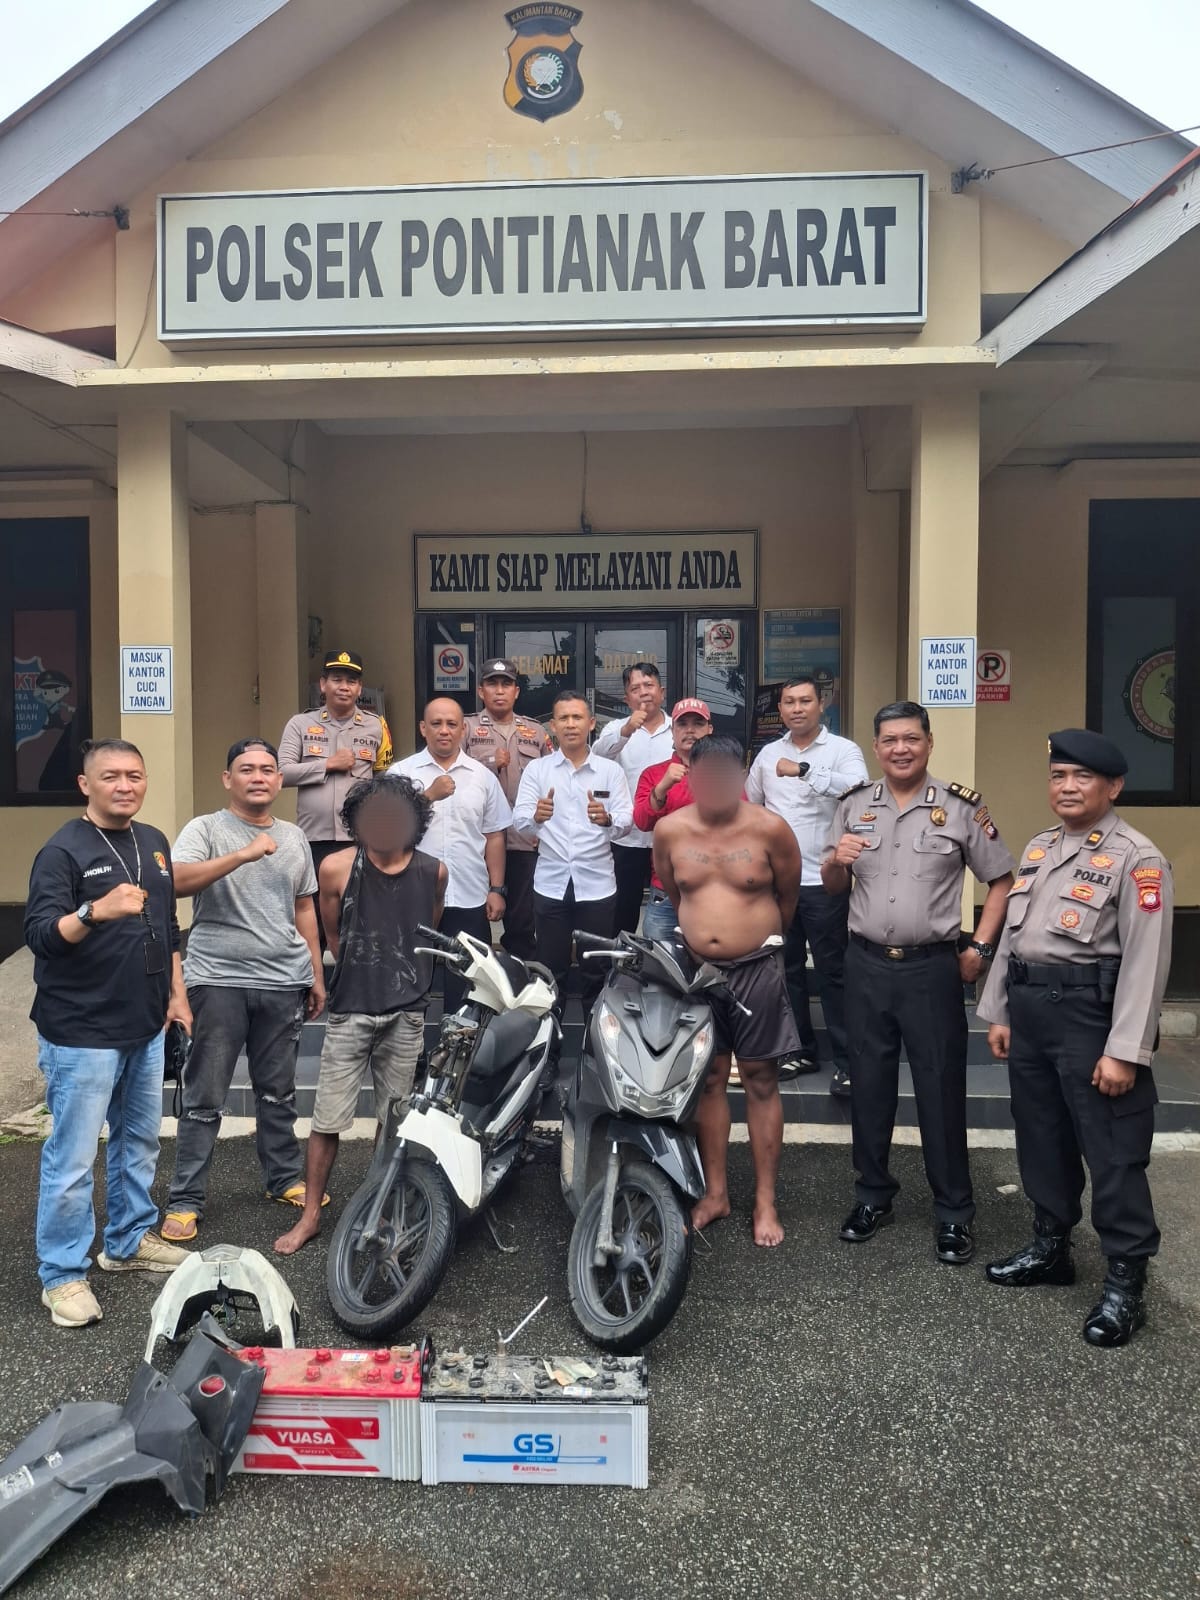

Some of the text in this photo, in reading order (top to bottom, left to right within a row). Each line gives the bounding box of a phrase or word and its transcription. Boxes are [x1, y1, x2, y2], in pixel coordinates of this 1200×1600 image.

[511, 6, 577, 22] KALIMANTAN BARAT
[186, 206, 897, 303] POLSEK PONTIANAK BARAT
[429, 550, 742, 592] KAMI SIAP MELAYANI ANDA
[930, 643, 966, 655] MASUK
[130, 652, 163, 663] MASUK
[511, 655, 570, 675] SELAMAT
[928, 658, 968, 670] KANTOR
[128, 667, 165, 678] KANTOR
[936, 673, 959, 685] CUCI
[136, 681, 157, 693] CUCI
[928, 689, 967, 700] TANGAN
[129, 696, 165, 707] TANGAN
[1073, 867, 1112, 887] POLRI
[277, 1431, 335, 1445] YUASA
[513, 1433, 554, 1453] GS
